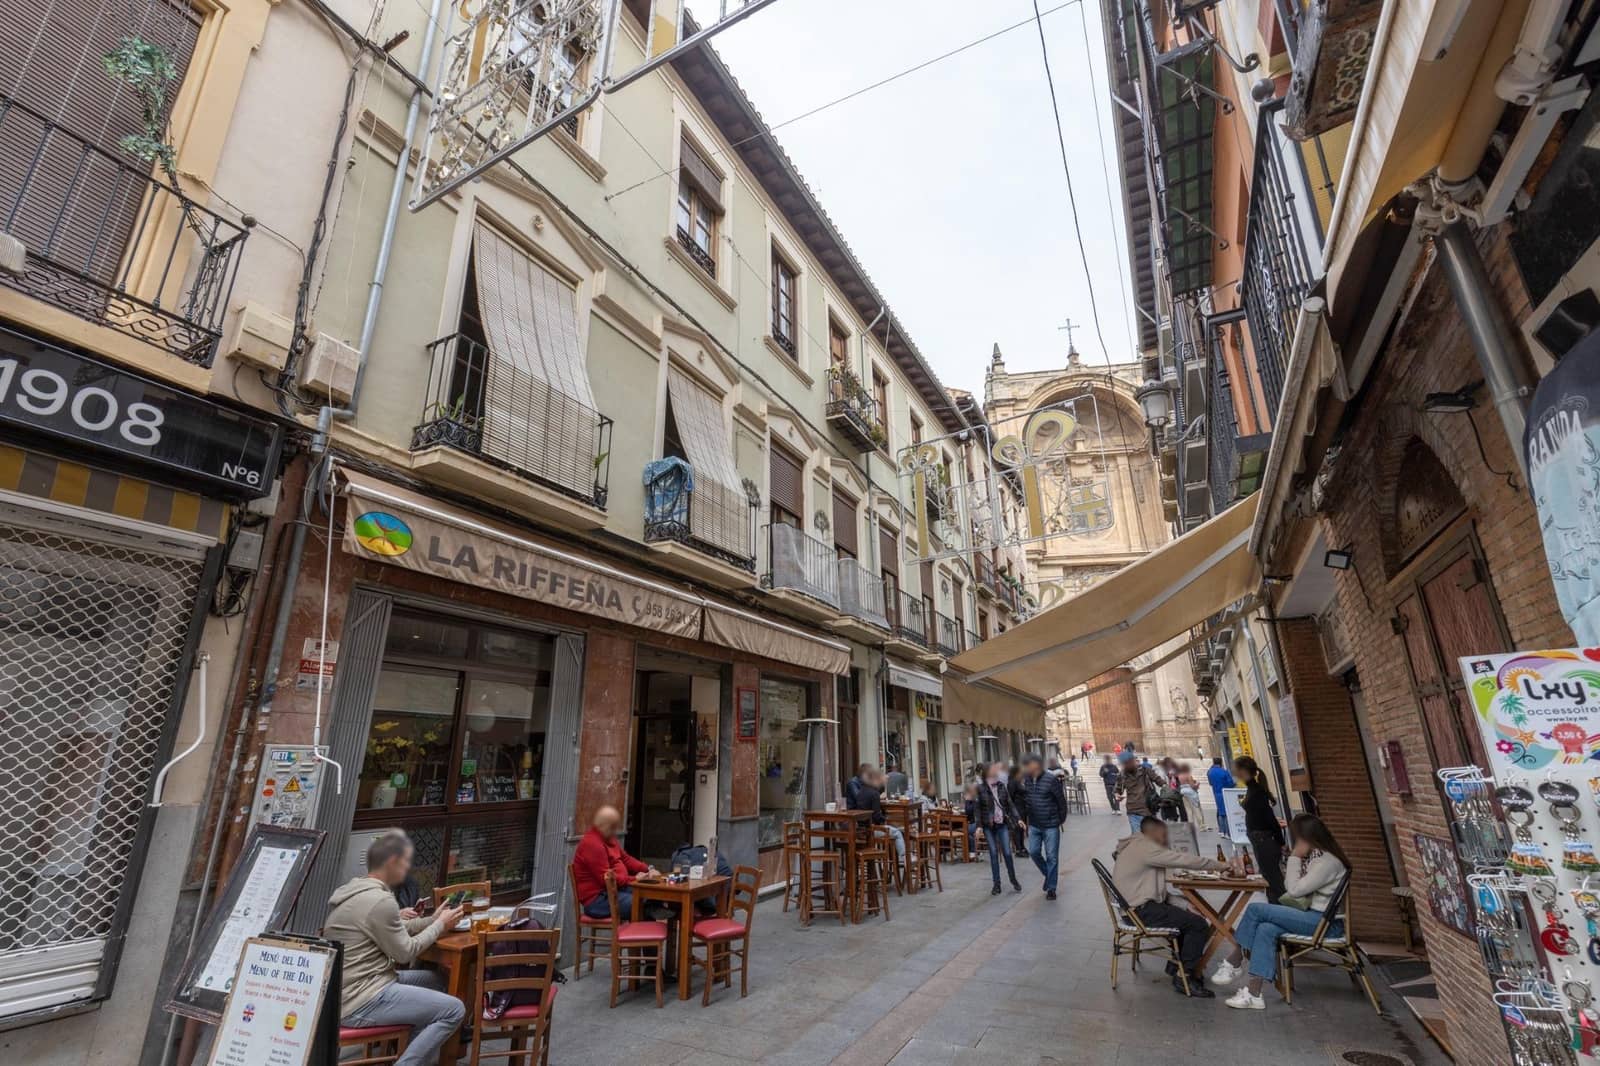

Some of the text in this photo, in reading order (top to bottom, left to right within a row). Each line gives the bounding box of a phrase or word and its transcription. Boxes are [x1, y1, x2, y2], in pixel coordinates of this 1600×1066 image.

[0, 359, 165, 446] 1908
[428, 535, 624, 612] LA RIFFEÑA
[646, 602, 663, 618] 958
